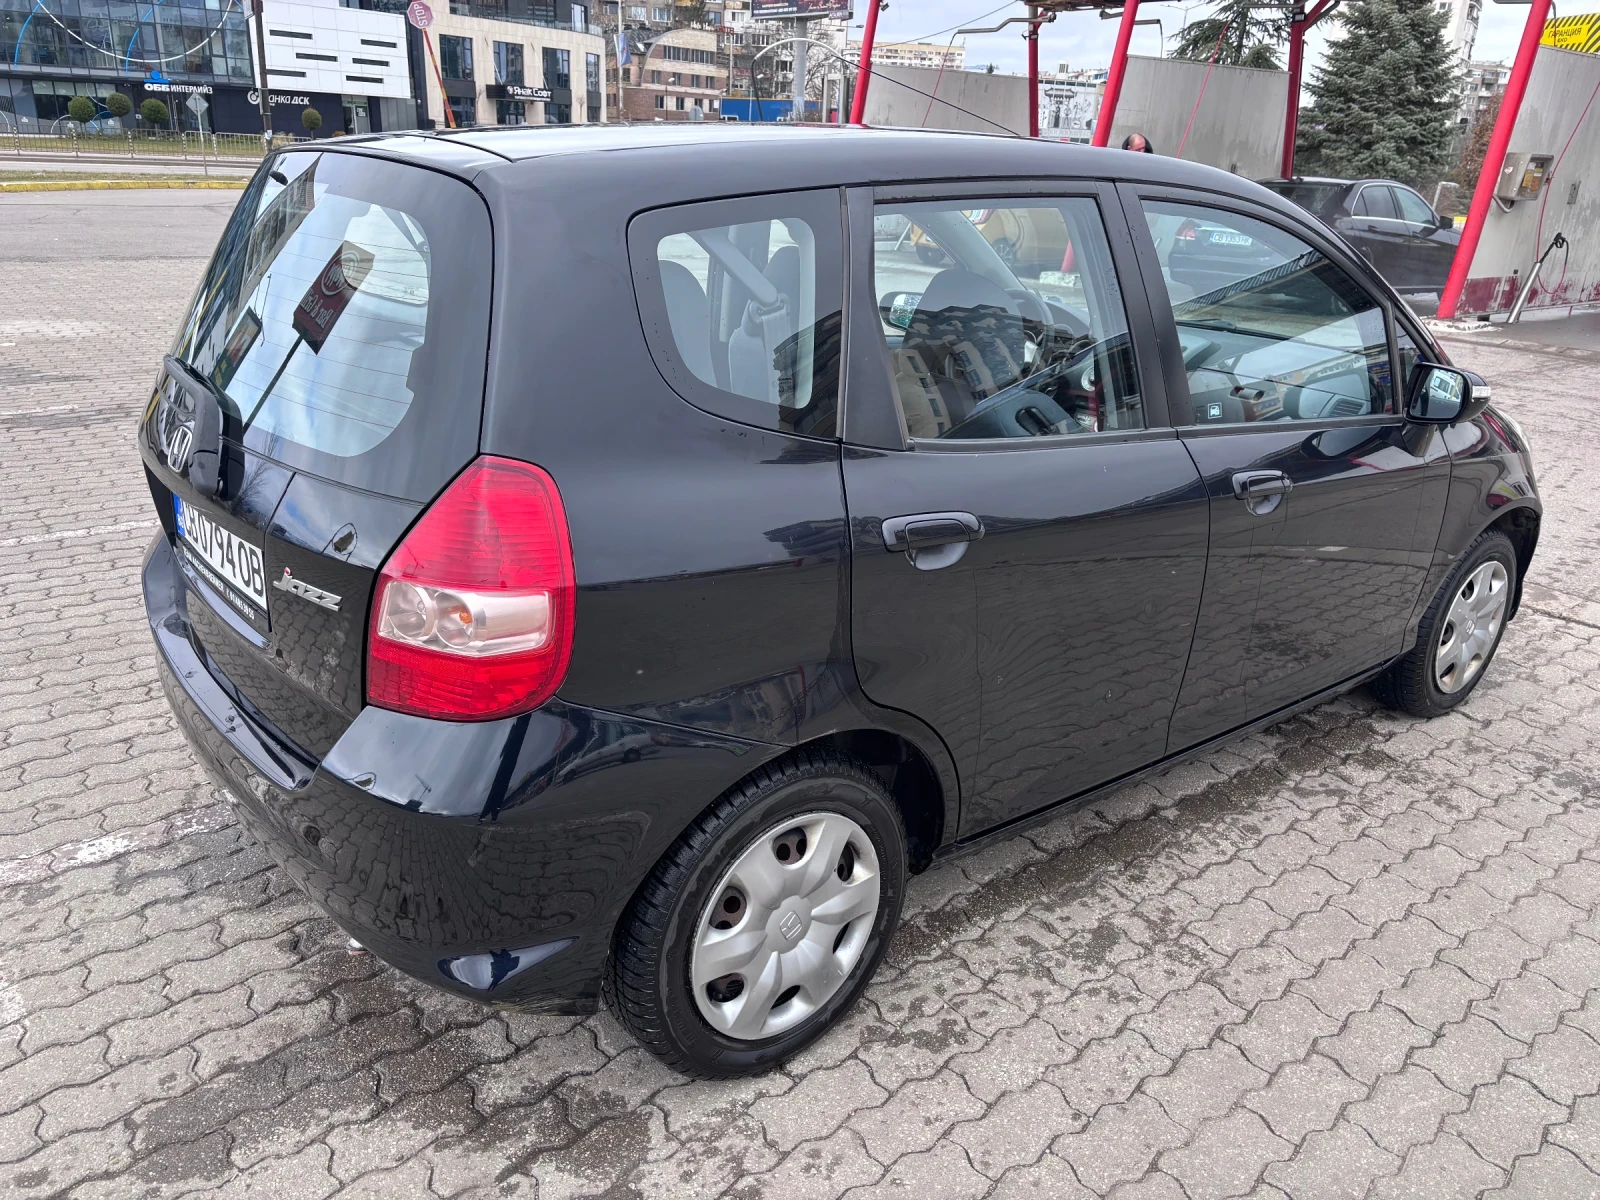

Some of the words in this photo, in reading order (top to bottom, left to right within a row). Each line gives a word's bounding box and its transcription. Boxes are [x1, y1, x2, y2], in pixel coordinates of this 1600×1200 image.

[413, 4, 428, 26] STOP
[1548, 27, 1582, 38] ГАРАНЦИЯ
[144, 83, 170, 91] ОББ
[170, 84, 213, 94] ИНТЕРЛИЙЗ
[268, 94, 291, 104] анка
[291, 96, 310, 105] ДСК
